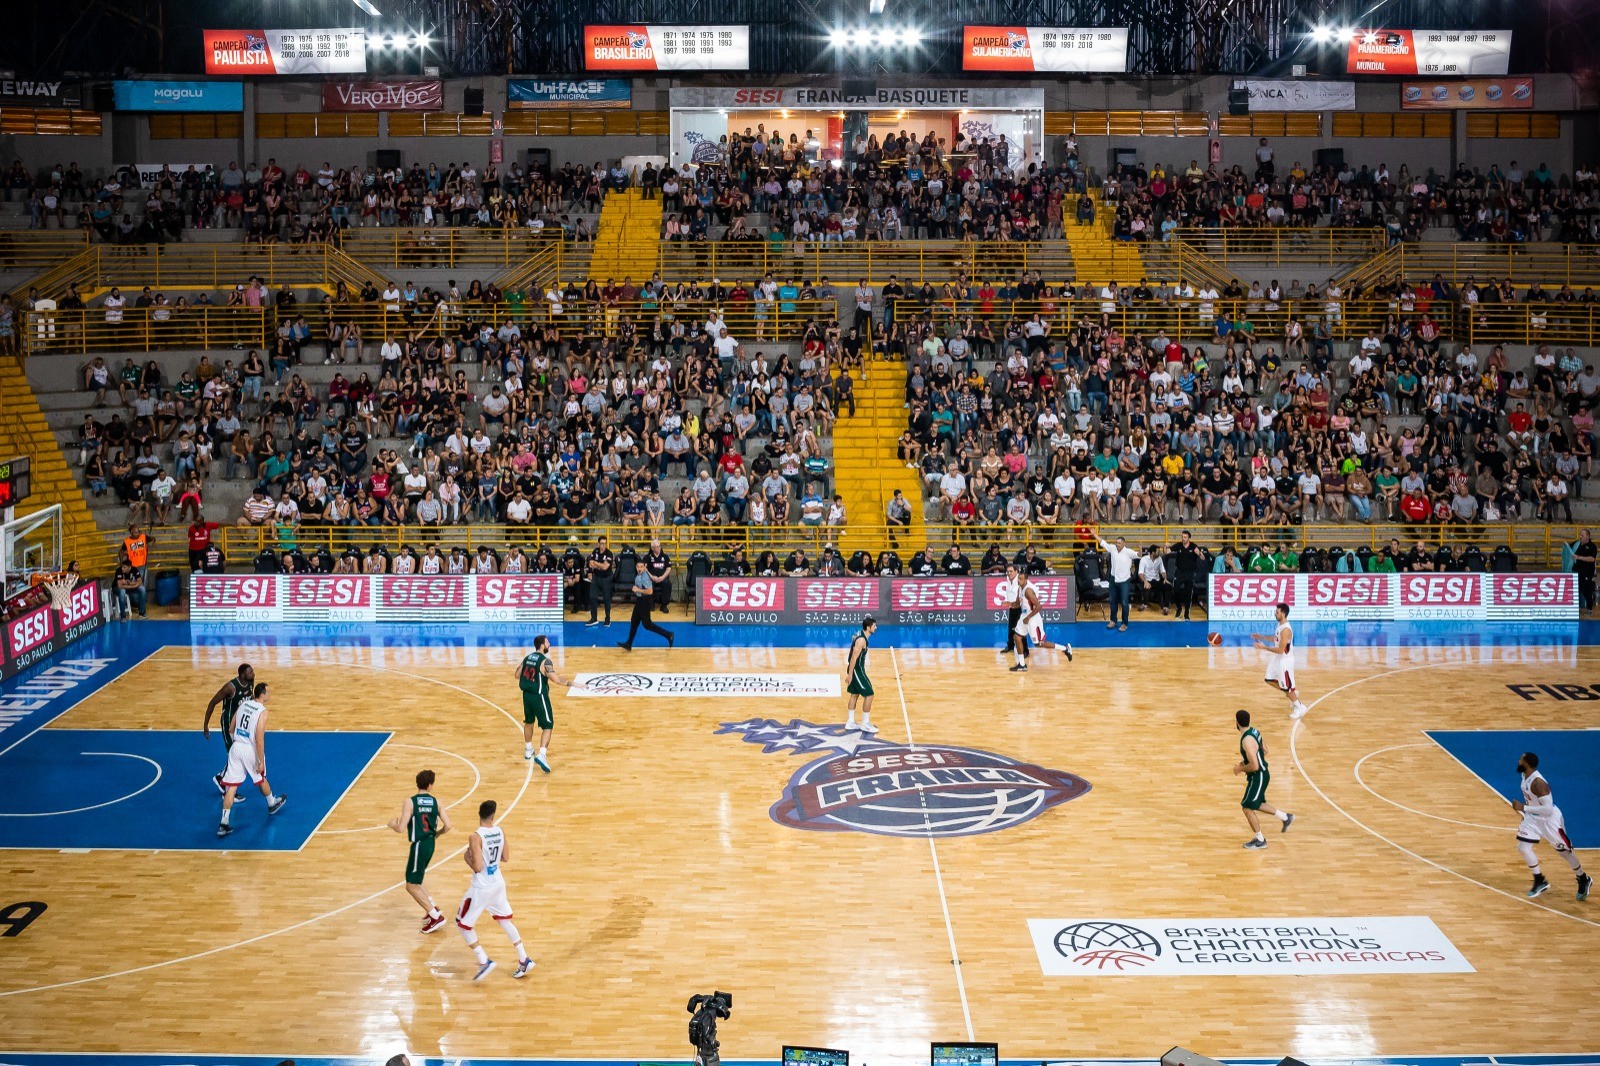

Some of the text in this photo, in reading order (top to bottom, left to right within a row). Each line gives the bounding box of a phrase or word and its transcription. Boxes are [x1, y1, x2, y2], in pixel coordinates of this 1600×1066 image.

[593, 36, 630, 47] CAMPEÃO
[973, 36, 1009, 47] CAMPEÃO
[1042, 33, 1112, 41] 1974 1975 1977 1980
[1428, 34, 1496, 42] 1993 1994 1997 1999
[213, 39, 249, 50] CAMPEÃO
[1357, 45, 1409, 55] PANAMERICANO
[214, 50, 269, 65] PAULISTA
[316, 50, 331, 58] 2007
[334, 50, 350, 58] 2018
[594, 47, 653, 60] BRASILEIRO
[971, 47, 1031, 58] SULAMERICANO
[1356, 61, 1386, 71] MUNDIAL
[1425, 64, 1457, 72] 1975 1980
[0, 80, 62, 97] EWAY
[336, 83, 429, 109] VERO MOC
[549, 93, 590, 101] MUNICIPAL
[735, 89, 783, 104] SESI
[877, 89, 969, 104] BASQUETE
[202, 578, 269, 605] SESI
[296, 578, 363, 605] SESI
[389, 578, 458, 605] SESI
[483, 578, 552, 605] SESI
[709, 581, 777, 607] SESI
[804, 582, 872, 608] SESI
[898, 582, 966, 607] SESI
[993, 581, 1060, 606] SSI
[1221, 578, 1288, 603] SESI
[1315, 578, 1381, 603] SESI
[1407, 577, 1473, 603] SESI
[1500, 577, 1566, 603] SESI
[484, 609, 507, 620] SÃO
[710, 611, 778, 623] SÃO PAULO
[805, 611, 829, 623] SÃO
[899, 610, 967, 622] SÃO PAULO
[994, 610, 1009, 622] SÃ
[1221, 607, 1276, 618] SÃO PAU
[1315, 607, 1382, 618] SÃO PAULO
[1408, 607, 1475, 618] SÃO PAULO
[13, 608, 49, 652] SESI
[65, 616, 98, 643] SÃO PAULO
[16, 641, 53, 670] SÃO PAULO
[239, 713, 251, 730] 15
[846, 752, 945, 774] SESI
[819, 767, 1034, 805] FRANCA
[1163, 926, 1350, 938] BASKETBALL
[1169, 938, 1383, 951] CHAMPIONS
